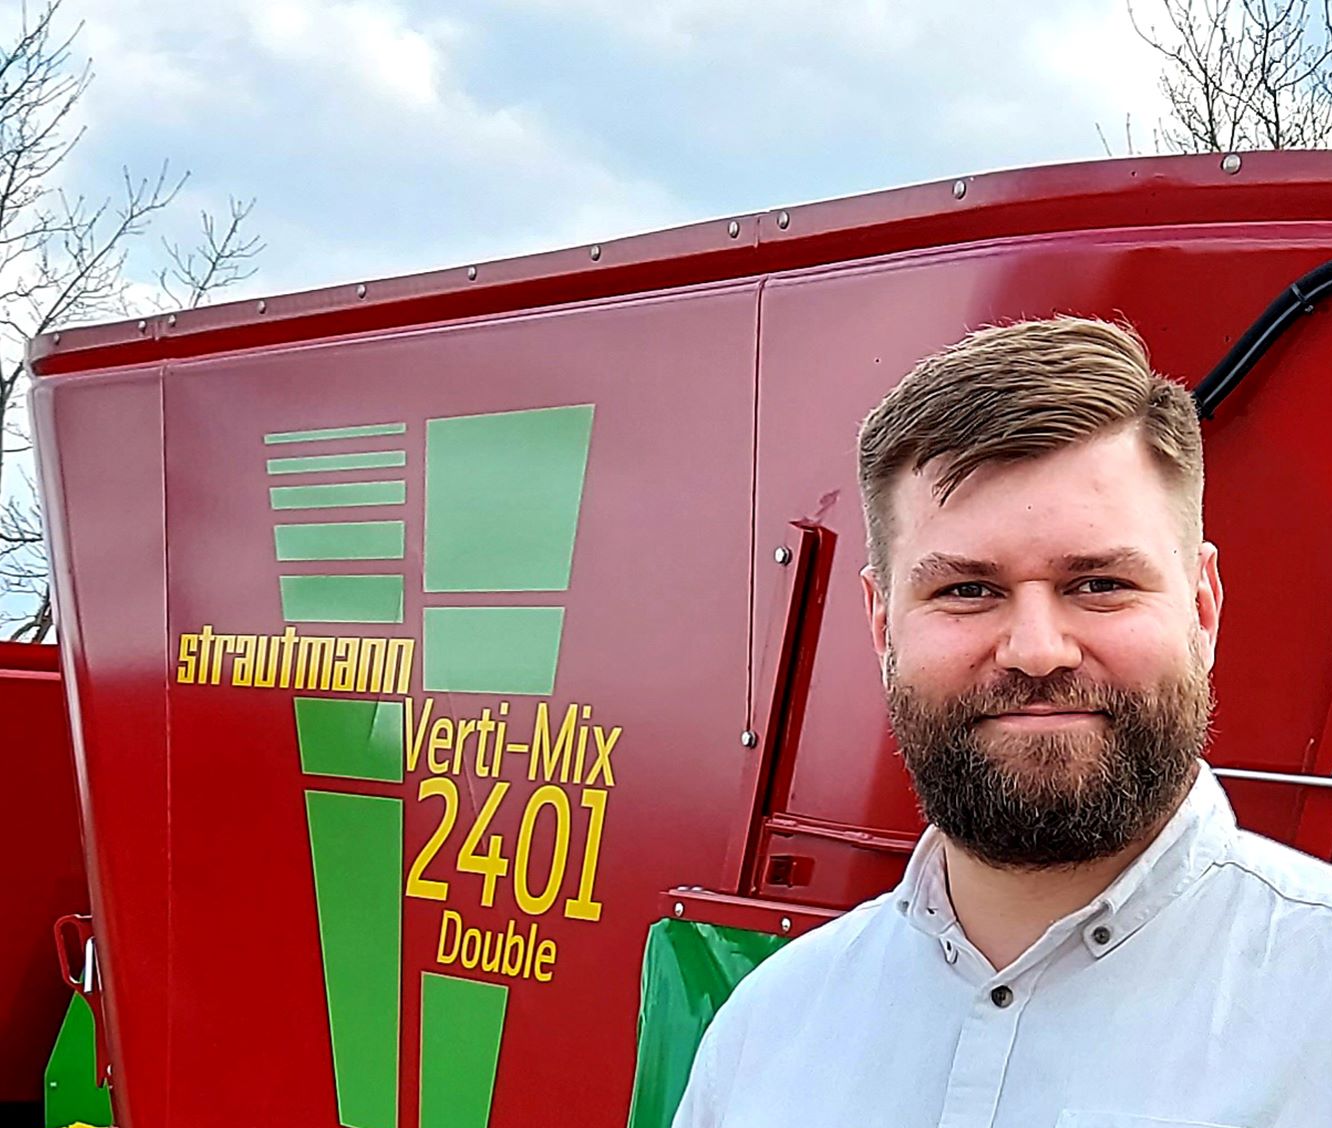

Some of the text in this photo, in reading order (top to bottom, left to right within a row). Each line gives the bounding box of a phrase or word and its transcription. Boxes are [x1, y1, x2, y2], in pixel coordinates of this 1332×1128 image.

[177, 625, 415, 694] strautmann
[405, 697, 622, 786] Verti-Mix
[405, 776, 608, 922] 2401
[436, 910, 557, 982] Double
